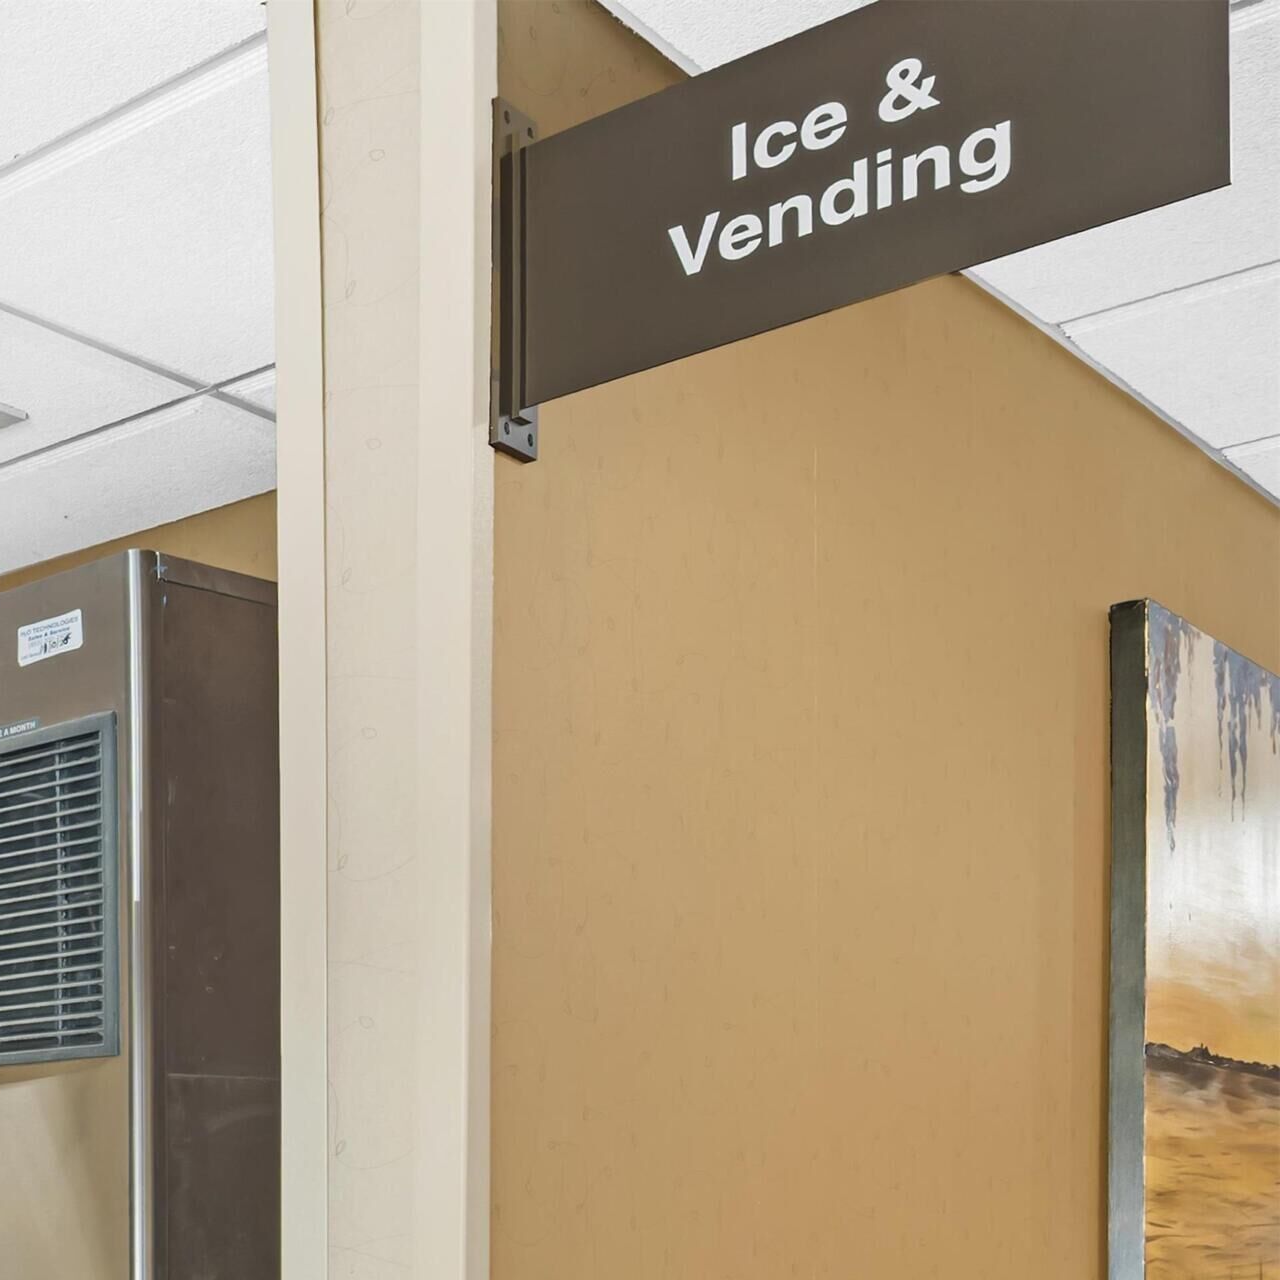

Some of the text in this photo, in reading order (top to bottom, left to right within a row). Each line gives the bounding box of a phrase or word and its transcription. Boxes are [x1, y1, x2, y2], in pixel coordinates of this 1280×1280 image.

[730, 57, 941, 180] Ice &
[667, 119, 1013, 277] Vending
[4, 728, 9, 736] A
[10, 720, 36, 734] MONTH
